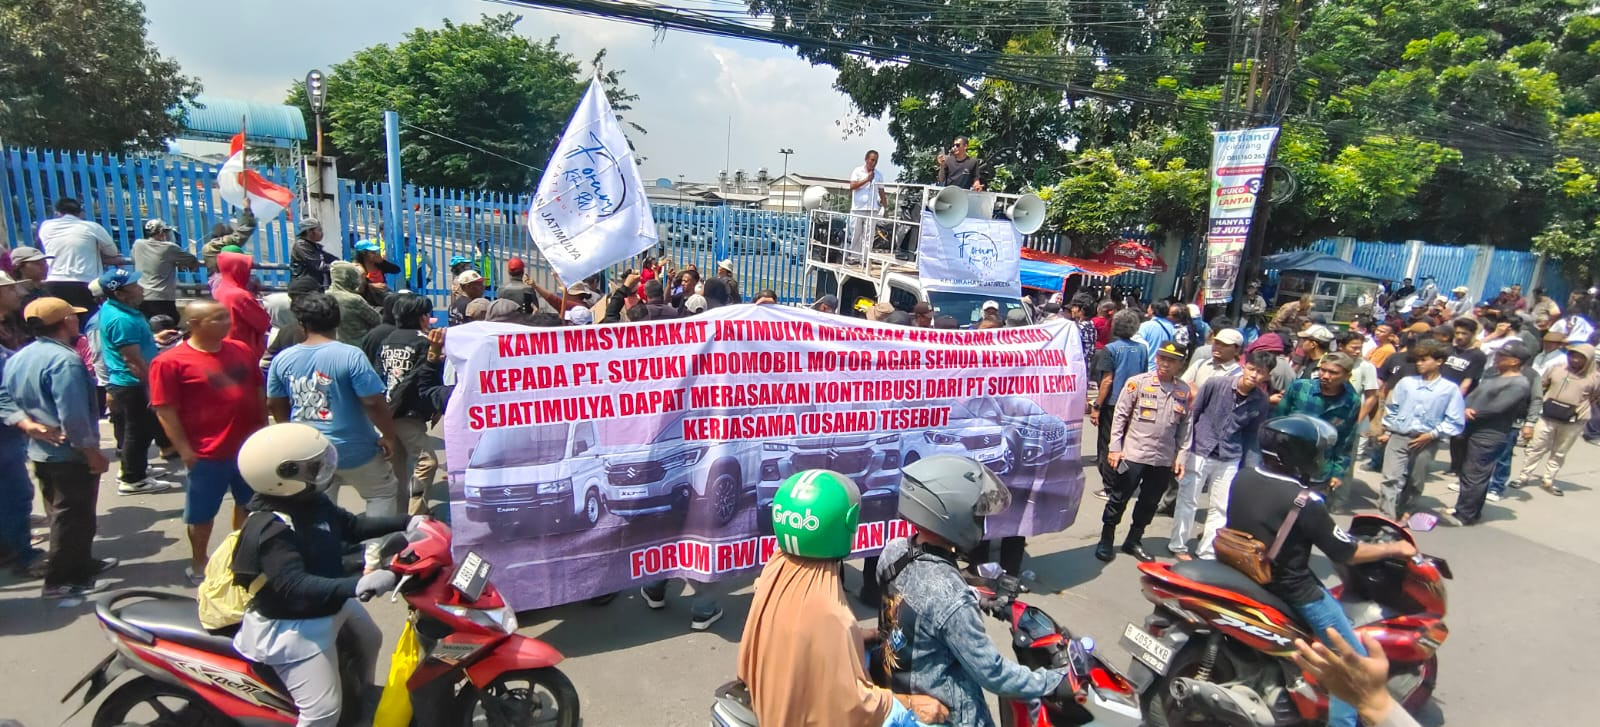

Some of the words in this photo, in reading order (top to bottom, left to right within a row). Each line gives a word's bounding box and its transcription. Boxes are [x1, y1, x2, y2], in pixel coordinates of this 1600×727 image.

[1218, 132, 1270, 143] Metland
[1218, 197, 1253, 206] LANTAI
[1221, 187, 1245, 195] RUKO
[1250, 180, 1260, 194] 3
[541, 212, 582, 261] JATIMULYA
[497, 331, 558, 358] KAMI
[564, 320, 707, 354] MASYARAKAT
[713, 320, 815, 342] JATIMULYA
[997, 328, 1054, 346] (USAHA)
[479, 363, 567, 394] KEPADA
[572, 362, 603, 386] PT.
[608, 355, 686, 383] SUZUKI
[692, 351, 803, 376] INDOMOBIL
[807, 351, 872, 373] MOTOR
[875, 350, 921, 371] AGAR
[925, 350, 978, 370] SEMUA
[468, 394, 615, 430] SEJATIMULYA
[620, 388, 686, 417] DAPAT
[690, 382, 810, 409] MERASAKAN
[815, 379, 922, 403] KONTRIBUSI
[925, 377, 963, 398] DARI
[966, 376, 984, 397] PT
[988, 375, 1040, 395] SUZUKI
[1043, 374, 1077, 393] LEWAT
[683, 414, 796, 441] KERJASAMA
[801, 410, 876, 435] (USAHA)
[881, 407, 951, 430] TESEBUT
[773, 504, 820, 531] Grab
[630, 541, 711, 577] FORUM
[716, 540, 756, 572] RW
[1134, 632, 1153, 650] 4052
